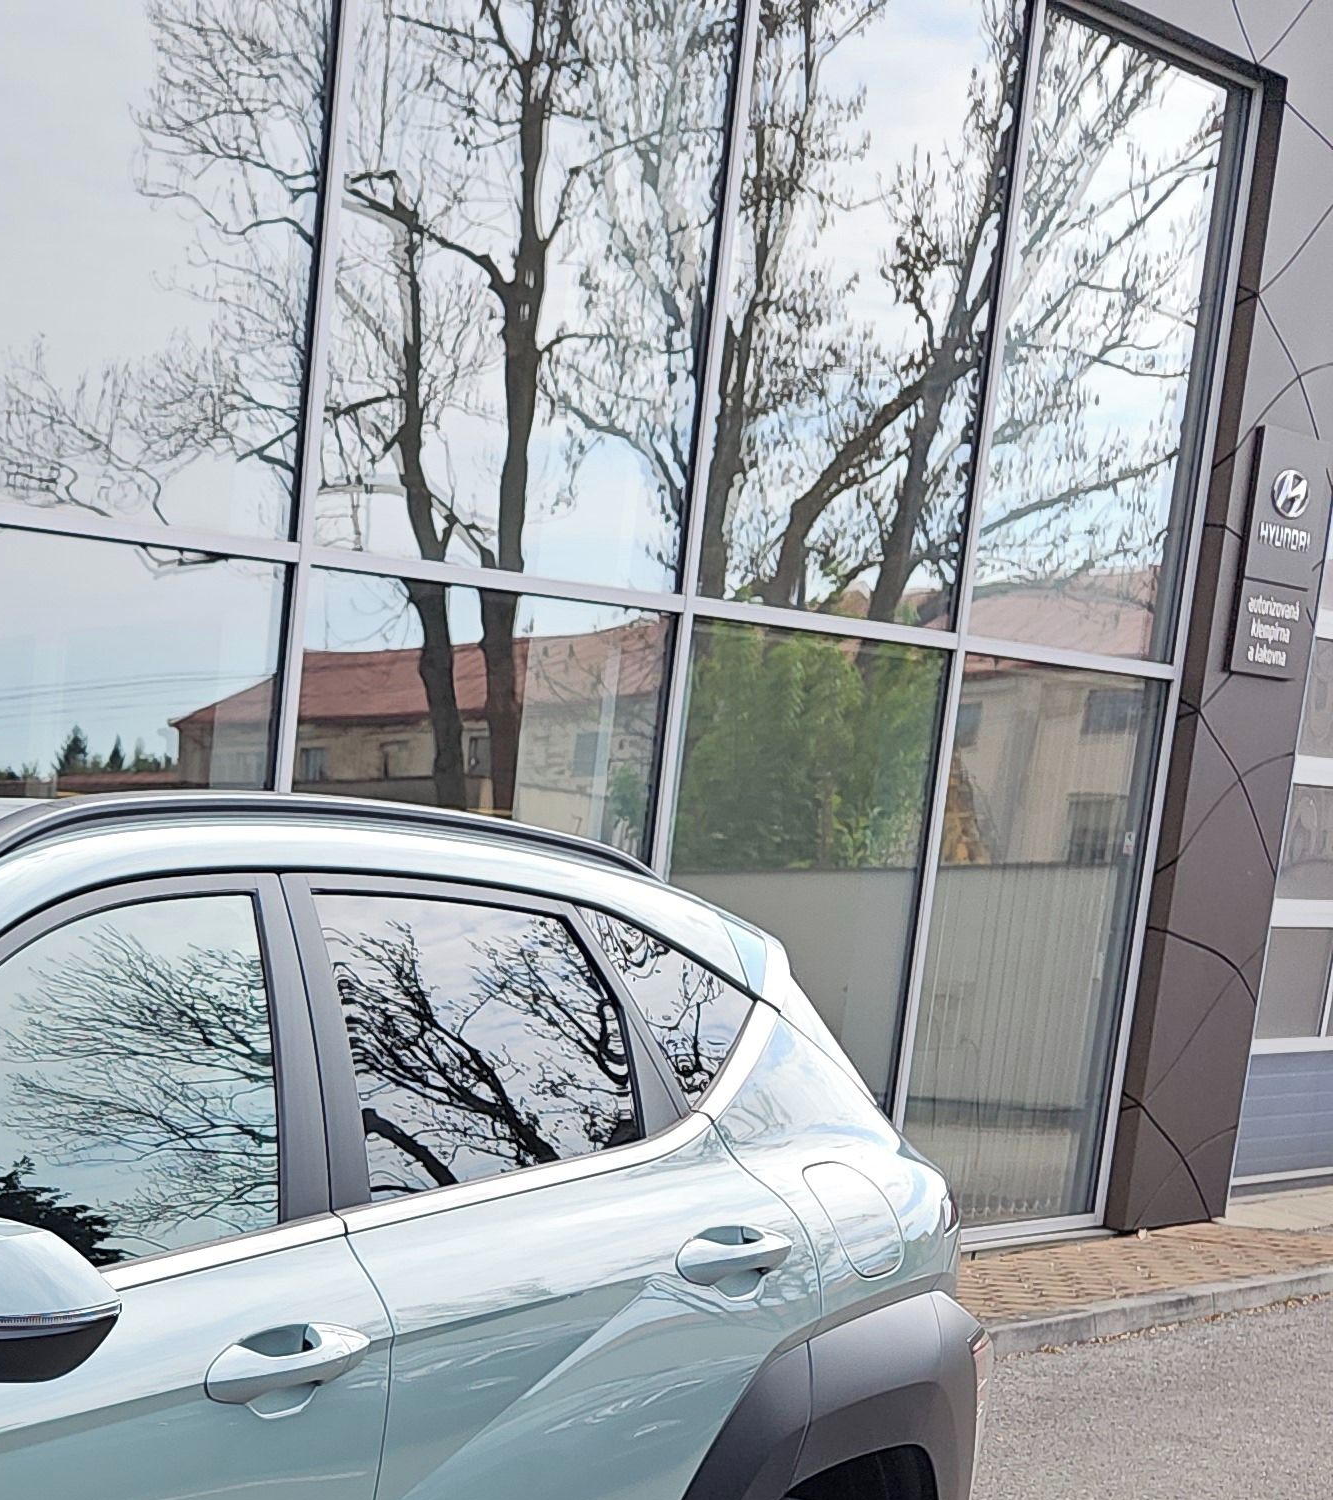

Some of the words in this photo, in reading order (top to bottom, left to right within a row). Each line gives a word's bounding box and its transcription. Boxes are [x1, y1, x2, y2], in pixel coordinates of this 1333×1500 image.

[1259, 521, 1311, 552] HYUNDAI
[1248, 595, 1300, 621] autorizovaná
[1255, 643, 1287, 666] lakovna
